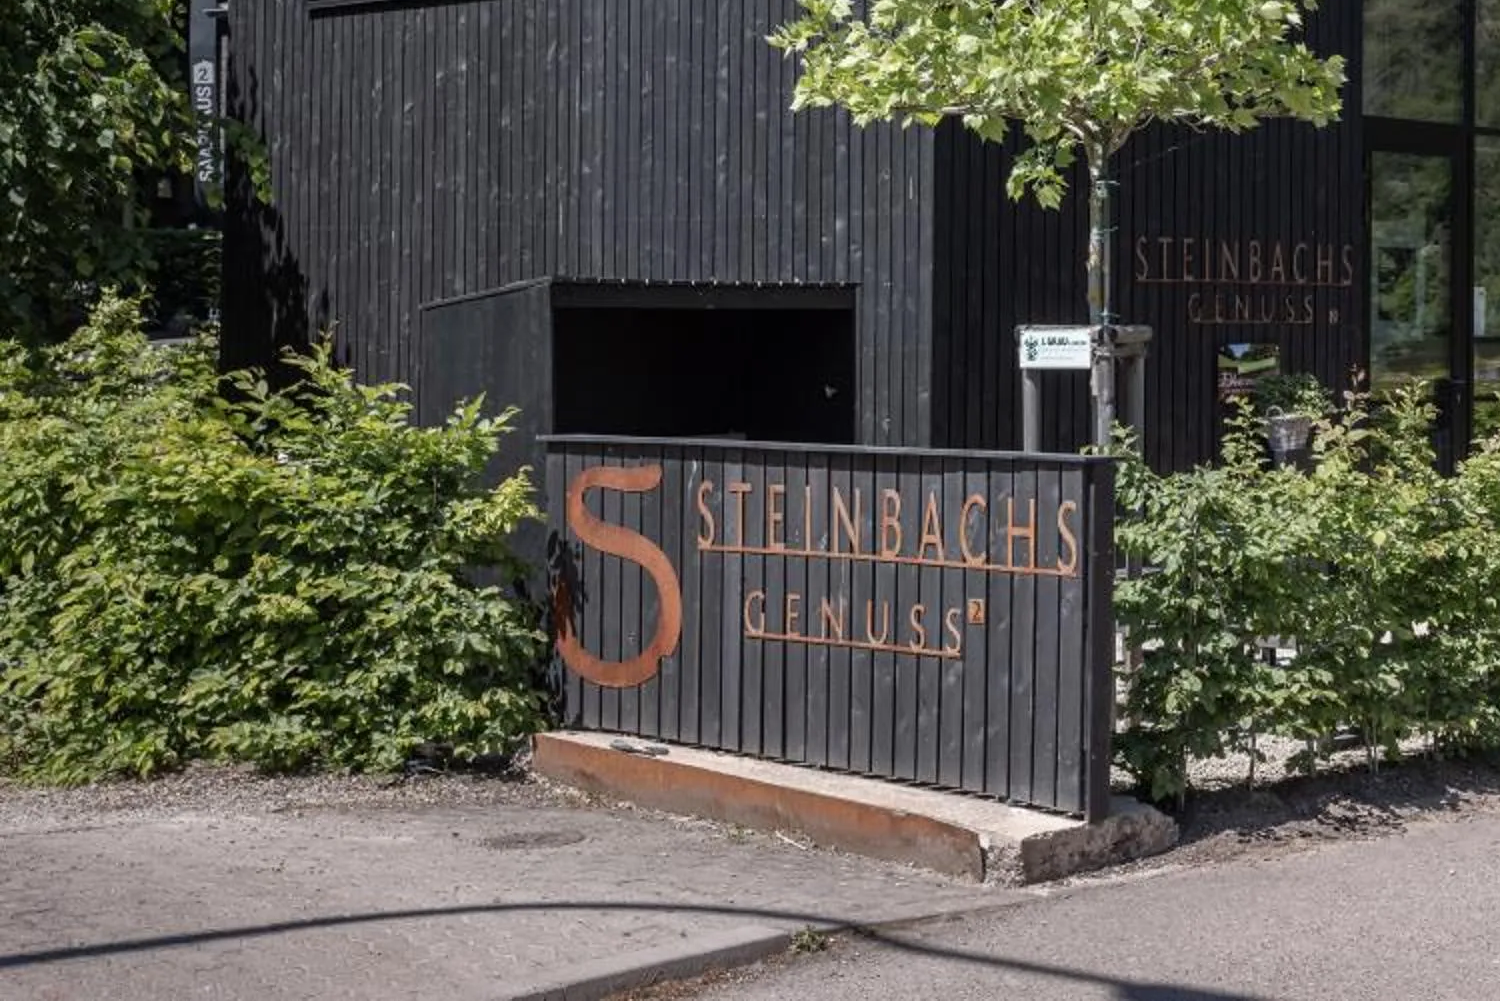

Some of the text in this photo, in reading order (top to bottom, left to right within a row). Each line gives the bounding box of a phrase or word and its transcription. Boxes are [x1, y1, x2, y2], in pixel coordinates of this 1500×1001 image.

[1135, 235, 1354, 286] STEINBACHS
[1188, 292, 1313, 324] GENUSS
[696, 479, 1078, 574] STEINBACHS
[557, 464, 682, 688] S
